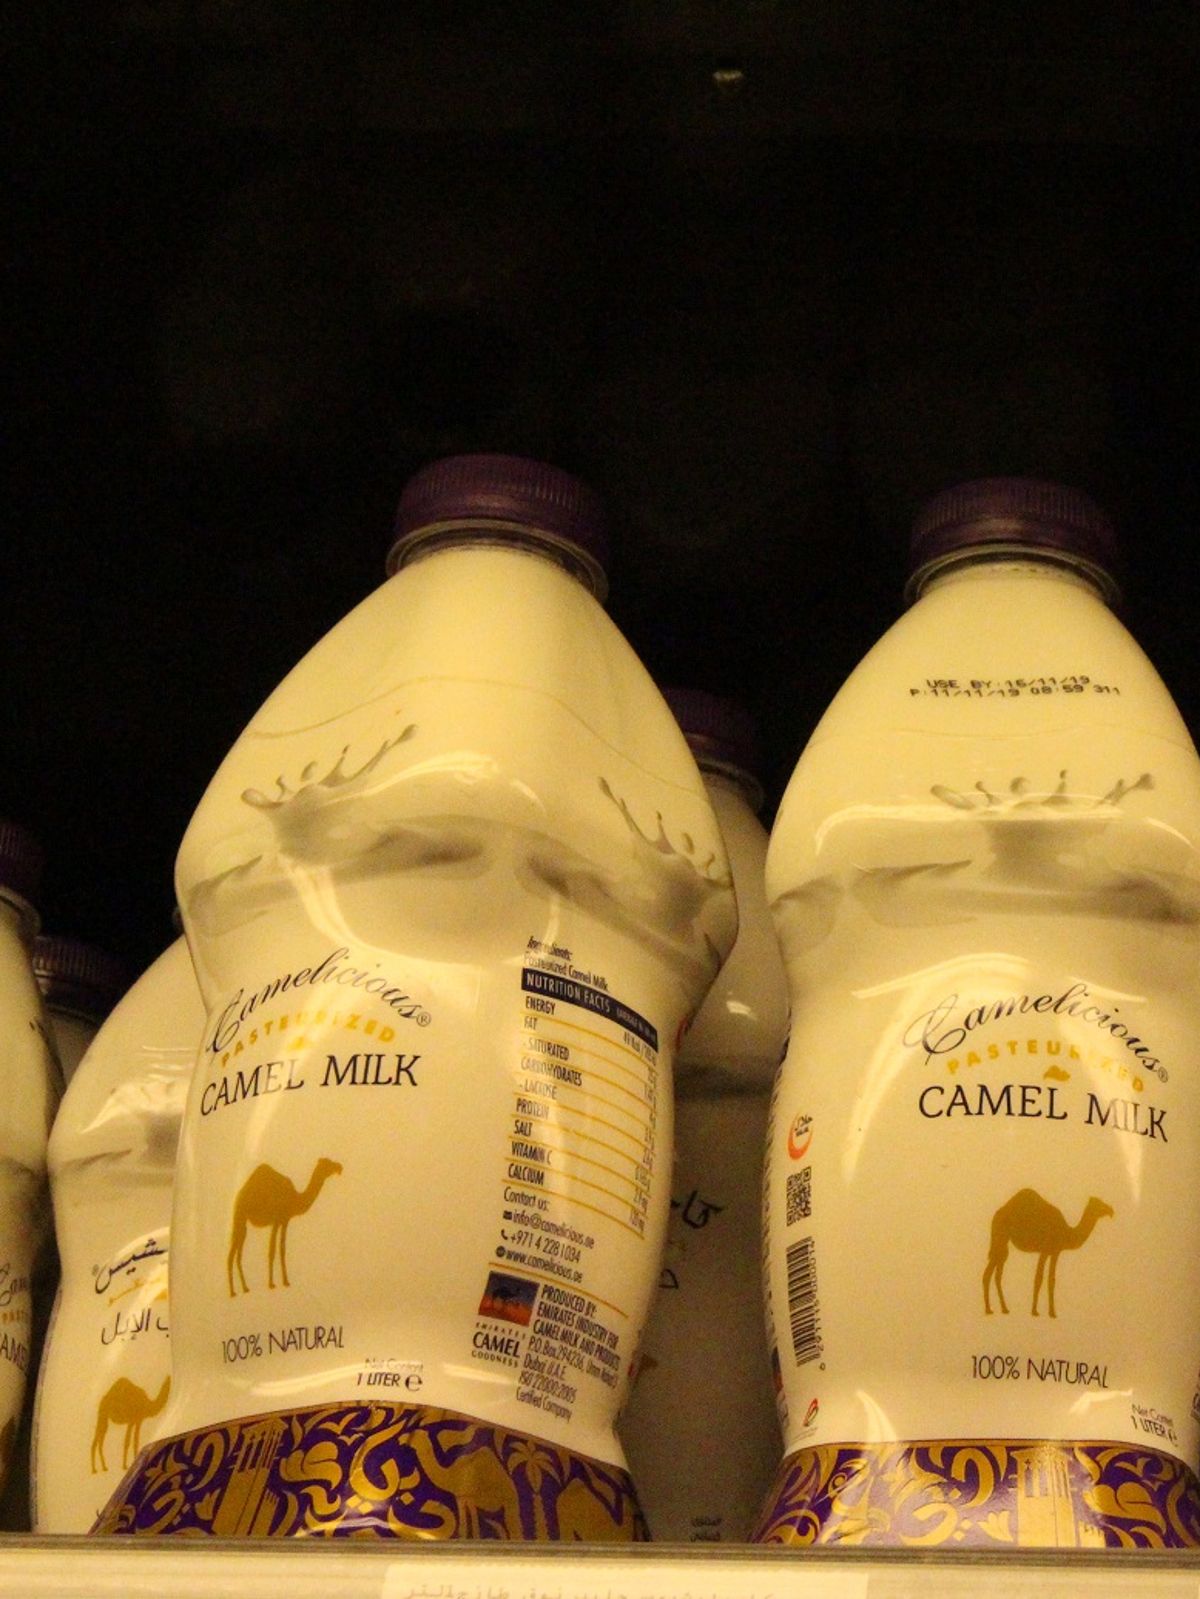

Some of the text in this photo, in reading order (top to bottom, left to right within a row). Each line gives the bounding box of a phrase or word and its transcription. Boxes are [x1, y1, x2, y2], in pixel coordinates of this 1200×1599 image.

[926, 679, 960, 689] USE
[526, 972, 611, 1013] NUTRITION FACTS
[525, 996, 556, 1016] ENERGY
[946, 1039, 1145, 1093] PASTEURZED
[200, 1053, 422, 1117] CAMEL MILK
[918, 1083, 1169, 1143] CAMEL MILK
[513, 1119, 534, 1137] SALT
[508, 1163, 545, 1186] CALCIUM
[503, 1186, 537, 1207] Contact
[221, 1325, 345, 1364] 100% NATURAL
[472, 1331, 521, 1358] CAMEL
[366, 1372, 402, 1388] LITER
[971, 1354, 1109, 1389] 100% NATURAL
[1141, 1417, 1168, 1438] LITER
